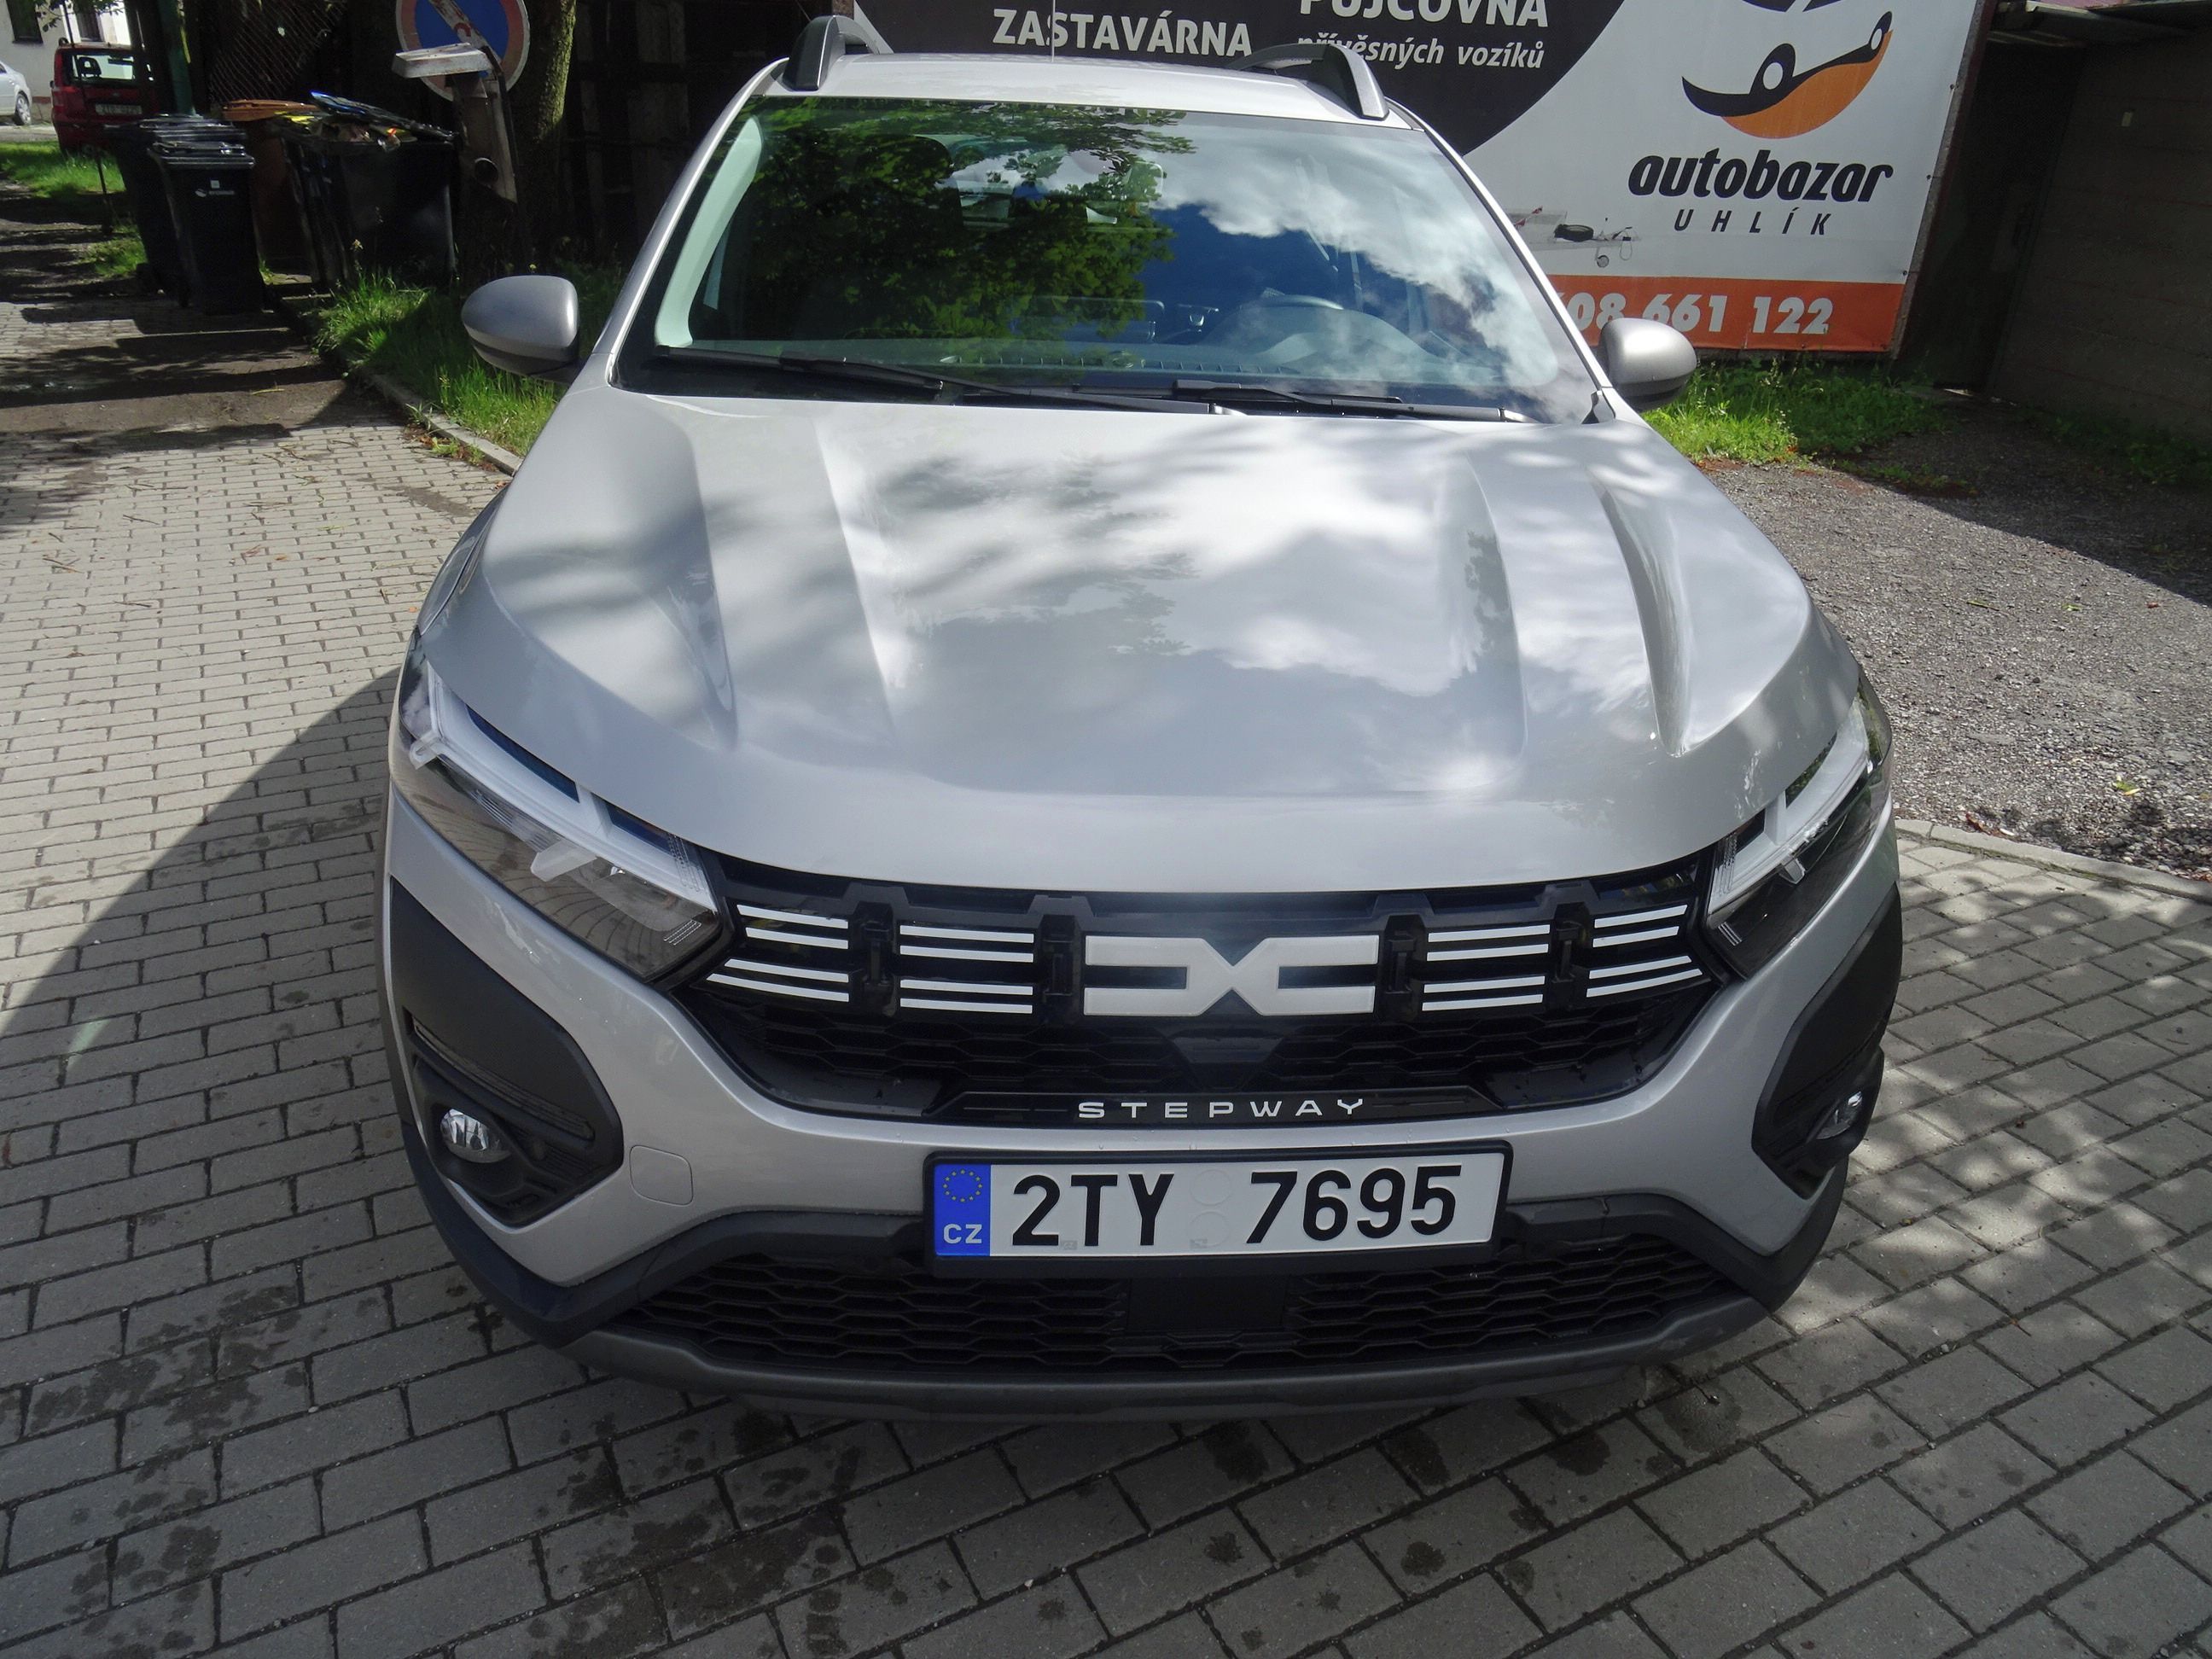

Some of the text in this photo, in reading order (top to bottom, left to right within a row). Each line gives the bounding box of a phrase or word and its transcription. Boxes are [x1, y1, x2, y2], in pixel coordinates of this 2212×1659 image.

[992, 10, 1253, 57] ZASTAVÁRNA
[1298, 32, 1545, 69] ěsných vozíků
[1627, 148, 1894, 202] autobazar
[1674, 207, 1831, 236] UHLÍK
[1557, 292, 1834, 335] 08 661 122
[1078, 1097, 1364, 1119] STEPWAY
[1012, 1164, 1462, 1246] 2TY 7695
[943, 1223, 983, 1244] CZ
